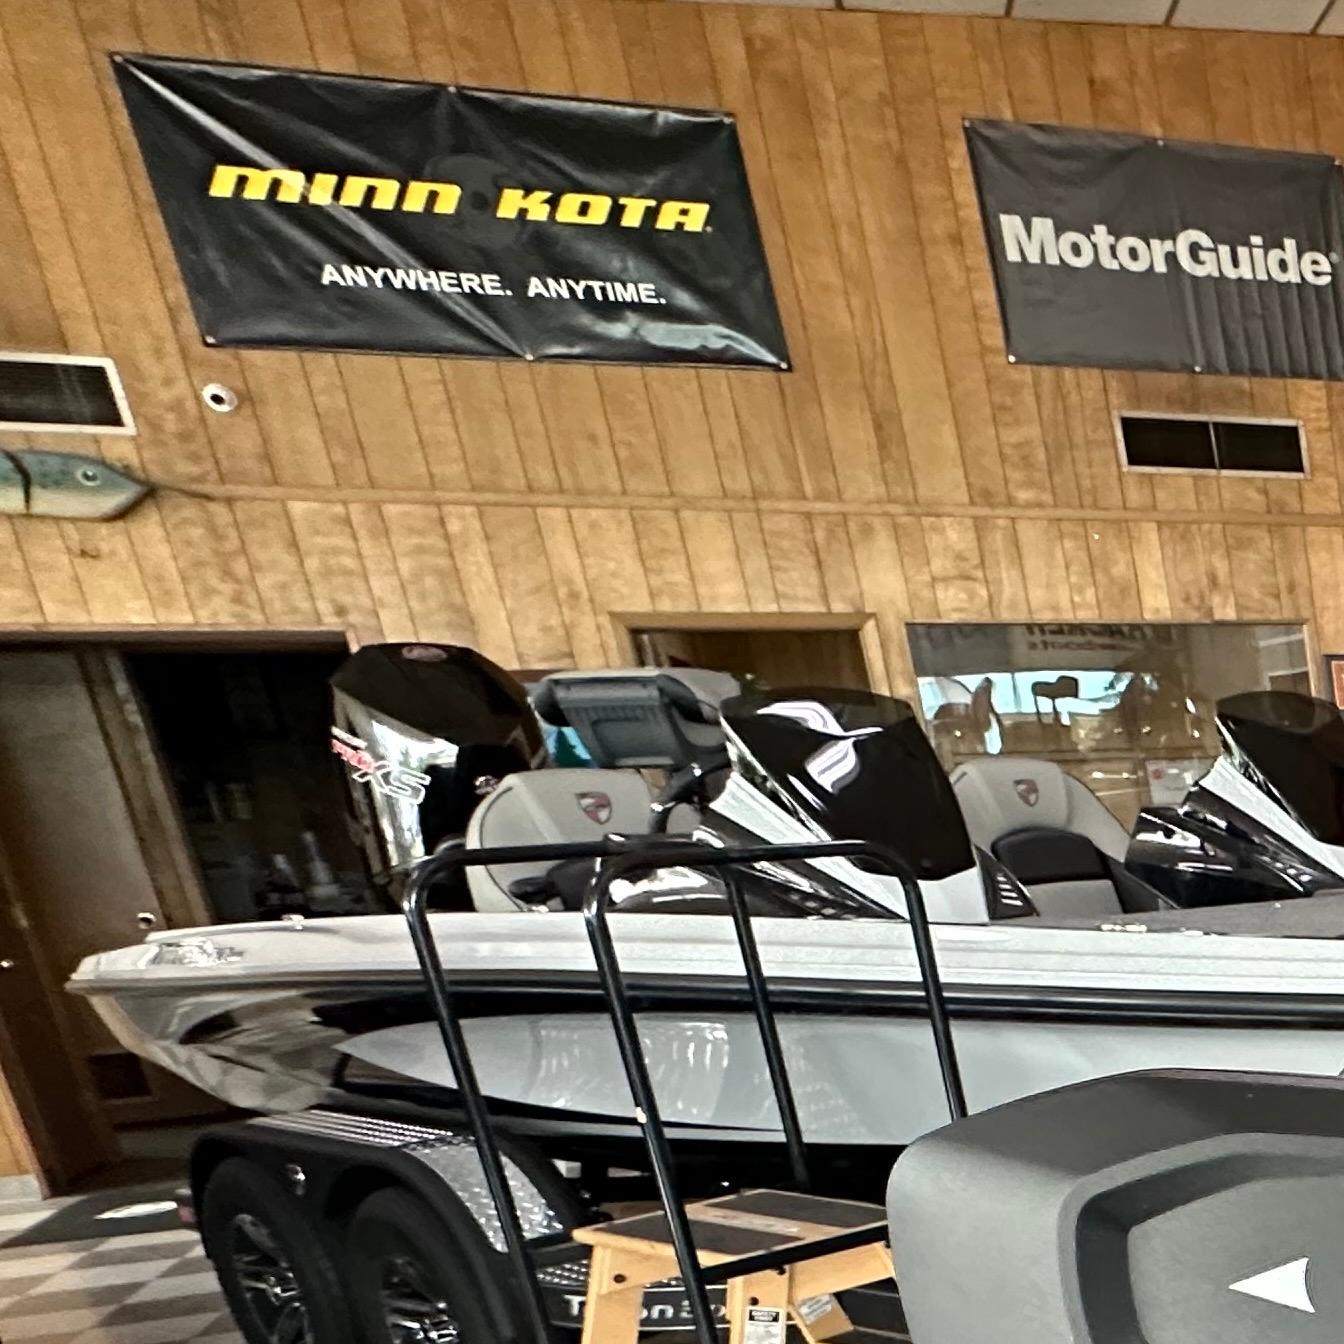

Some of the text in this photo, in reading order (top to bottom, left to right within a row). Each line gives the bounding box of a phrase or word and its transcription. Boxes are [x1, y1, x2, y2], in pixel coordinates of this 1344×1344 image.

[208, 164, 711, 232] MINN KOTA
[320, 263, 666, 304] ANYWHERE. ANYTIME.
[999, 213, 1333, 287] MotorGuide
